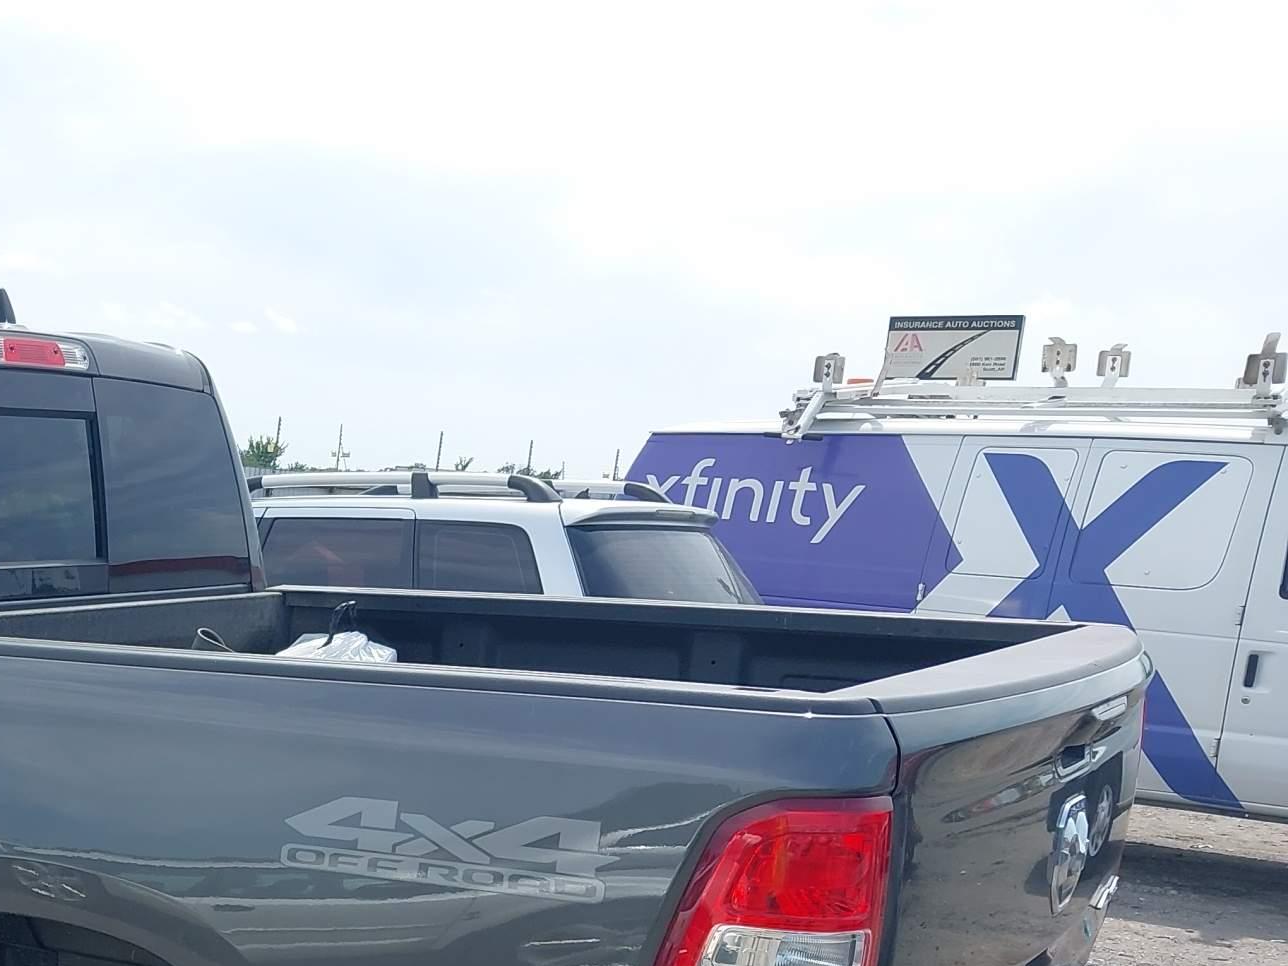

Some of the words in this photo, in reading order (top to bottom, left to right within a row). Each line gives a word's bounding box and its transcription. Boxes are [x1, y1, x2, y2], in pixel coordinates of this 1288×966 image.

[894, 320, 944, 329] INSURANCE
[945, 320, 970, 328] AUTO
[970, 319, 1016, 328] AUCTIONS
[646, 458, 866, 544] xfinity
